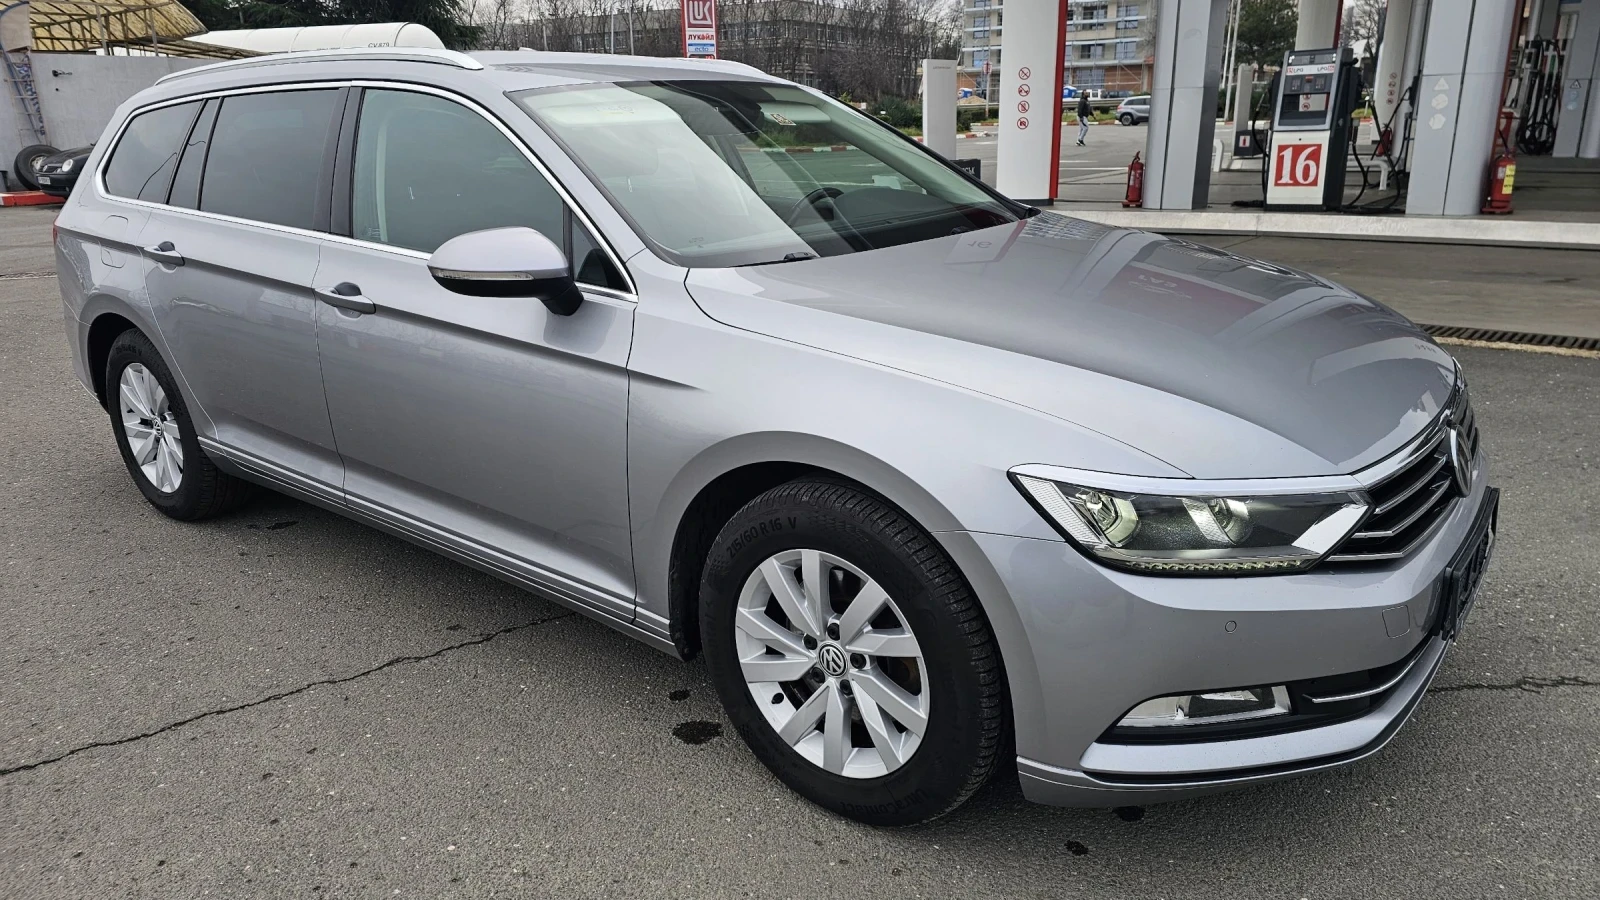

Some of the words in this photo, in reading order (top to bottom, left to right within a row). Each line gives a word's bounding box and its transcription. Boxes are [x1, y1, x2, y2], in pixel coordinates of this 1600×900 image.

[1277, 146, 1317, 184] 16
[727, 526, 758, 558] 215/60
[788, 516, 797, 530] V
